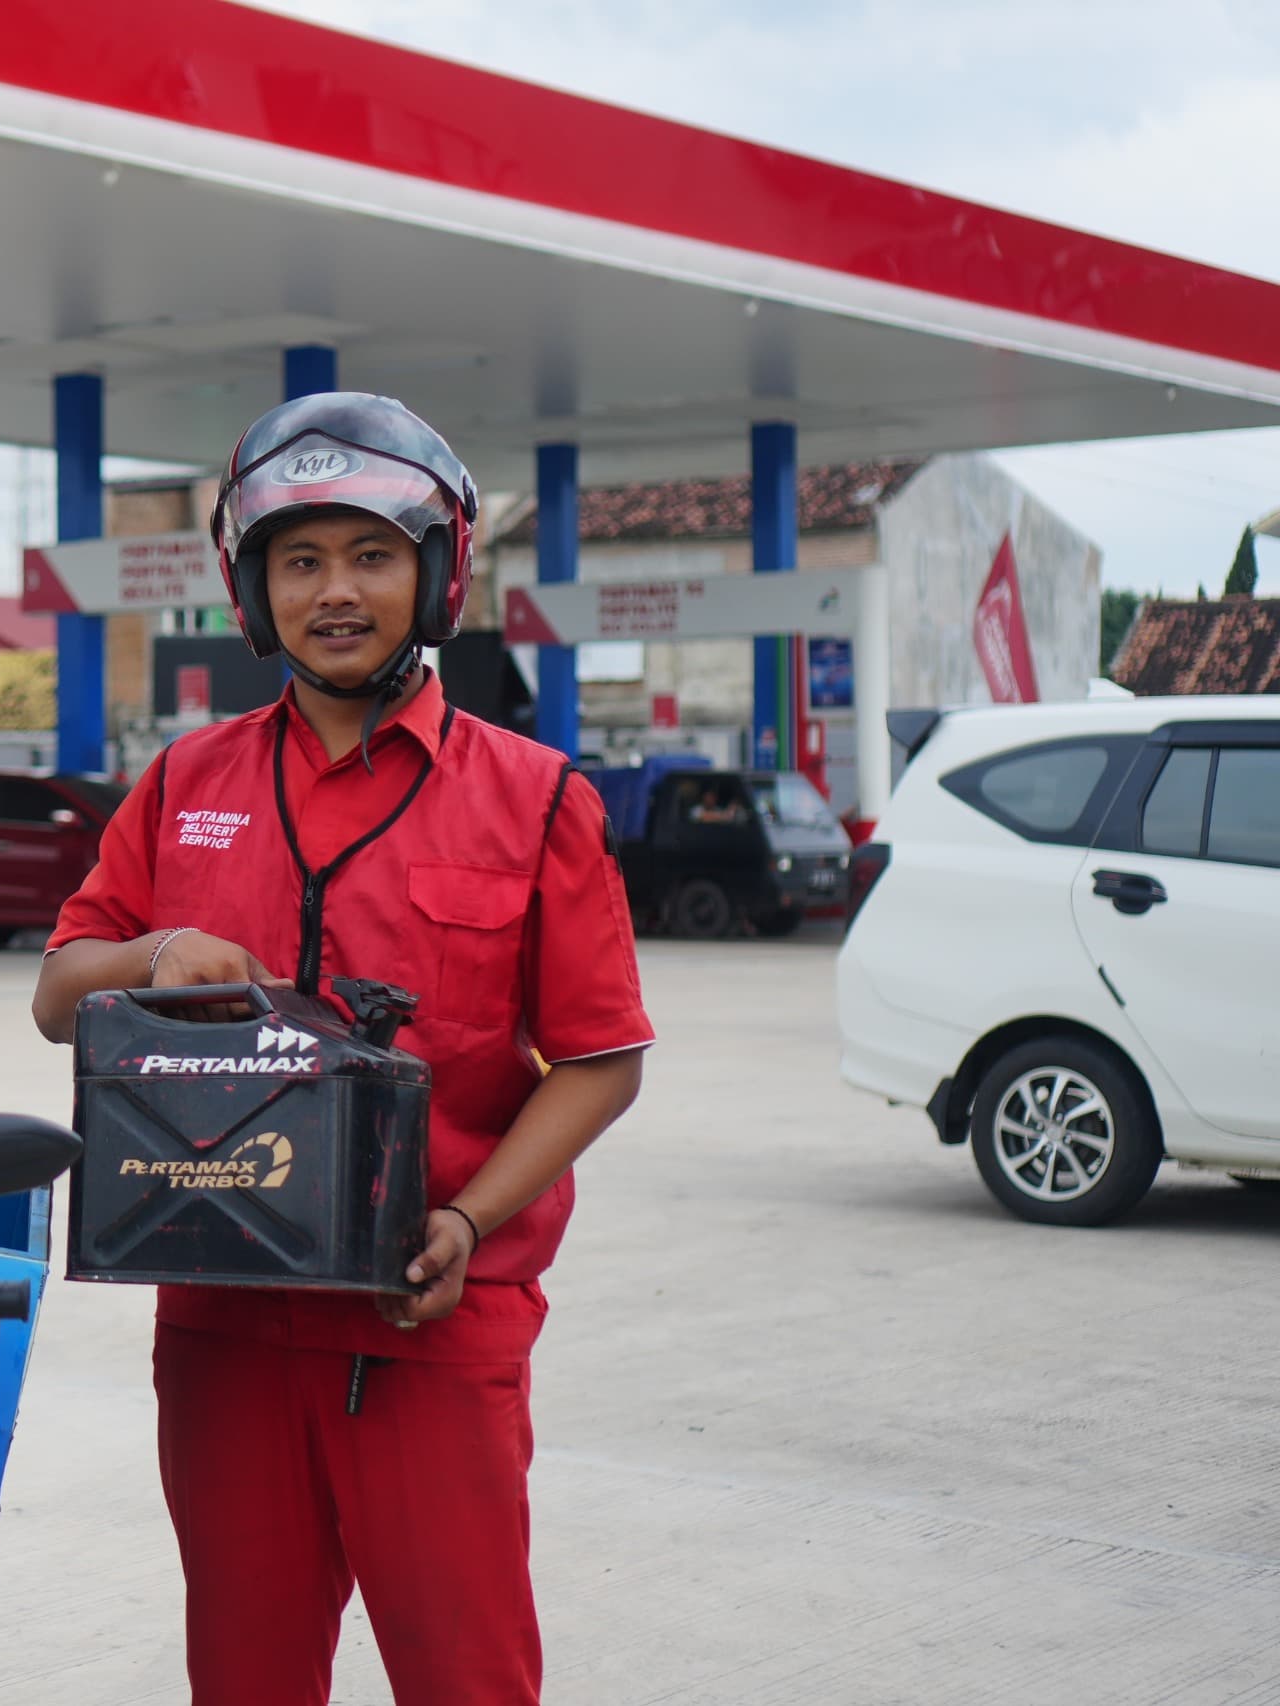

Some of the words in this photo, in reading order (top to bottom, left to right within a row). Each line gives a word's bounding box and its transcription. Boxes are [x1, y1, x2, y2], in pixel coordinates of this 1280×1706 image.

[176, 810, 251, 826] PERTAMINA
[180, 823, 239, 837] DELIVERY
[179, 834, 232, 849] SERVICE
[140, 1055, 317, 1074] PERTAMAX
[120, 1159, 259, 1175] PERTAMAX
[169, 1175, 256, 1188] TURBO
